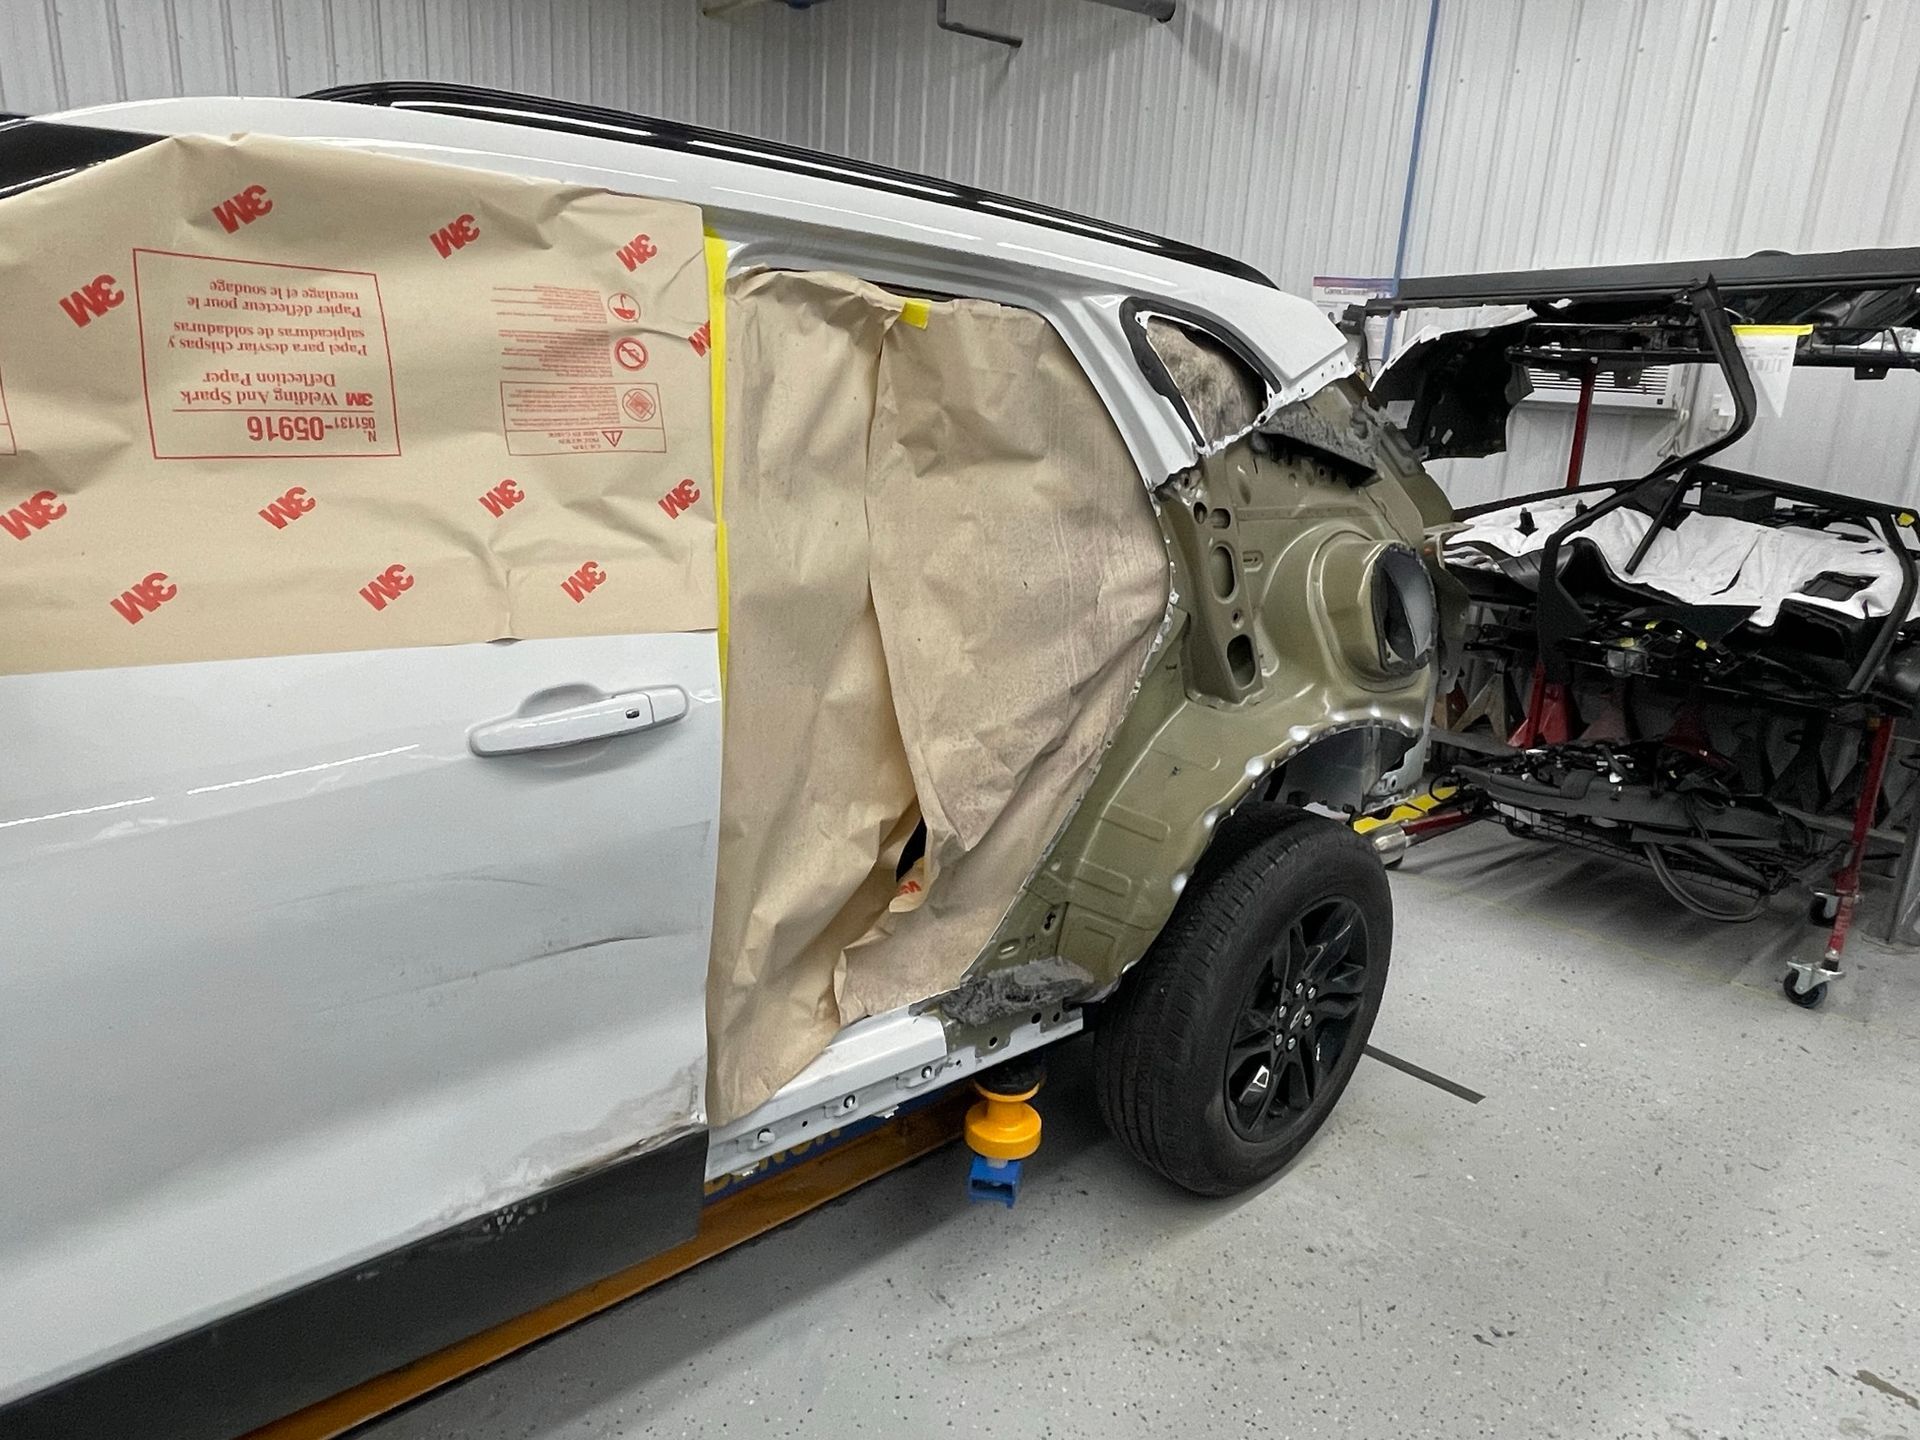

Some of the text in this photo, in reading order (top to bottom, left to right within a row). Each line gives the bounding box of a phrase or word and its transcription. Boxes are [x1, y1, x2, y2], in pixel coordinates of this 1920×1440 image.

[213, 185, 274, 233] 3M
[430, 213, 481, 258] 3M
[616, 233, 658, 272] 3M
[59, 274, 126, 328] 3M
[187, 297, 361, 318] Papier déflecteur pour le
[210, 280, 266, 296] soudage
[270, 287, 282, 298] le
[286, 288, 298, 298] et
[167, 336, 367, 356] Papel para desviar chispas y
[173, 322, 365, 340] salpicaduras de soldaduras
[688, 320, 711, 357] M
[180, 388, 373, 406] 3M Welding And Spark
[203, 370, 336, 387] Deflection Paper
[0, 490, 68, 540] 3M
[259, 486, 317, 529] 3M
[478, 478, 526, 519] 3M
[658, 478, 701, 520] 3M
[111, 571, 178, 624] 3M
[359, 563, 415, 611] 3M
[560, 560, 607, 604] 3M
